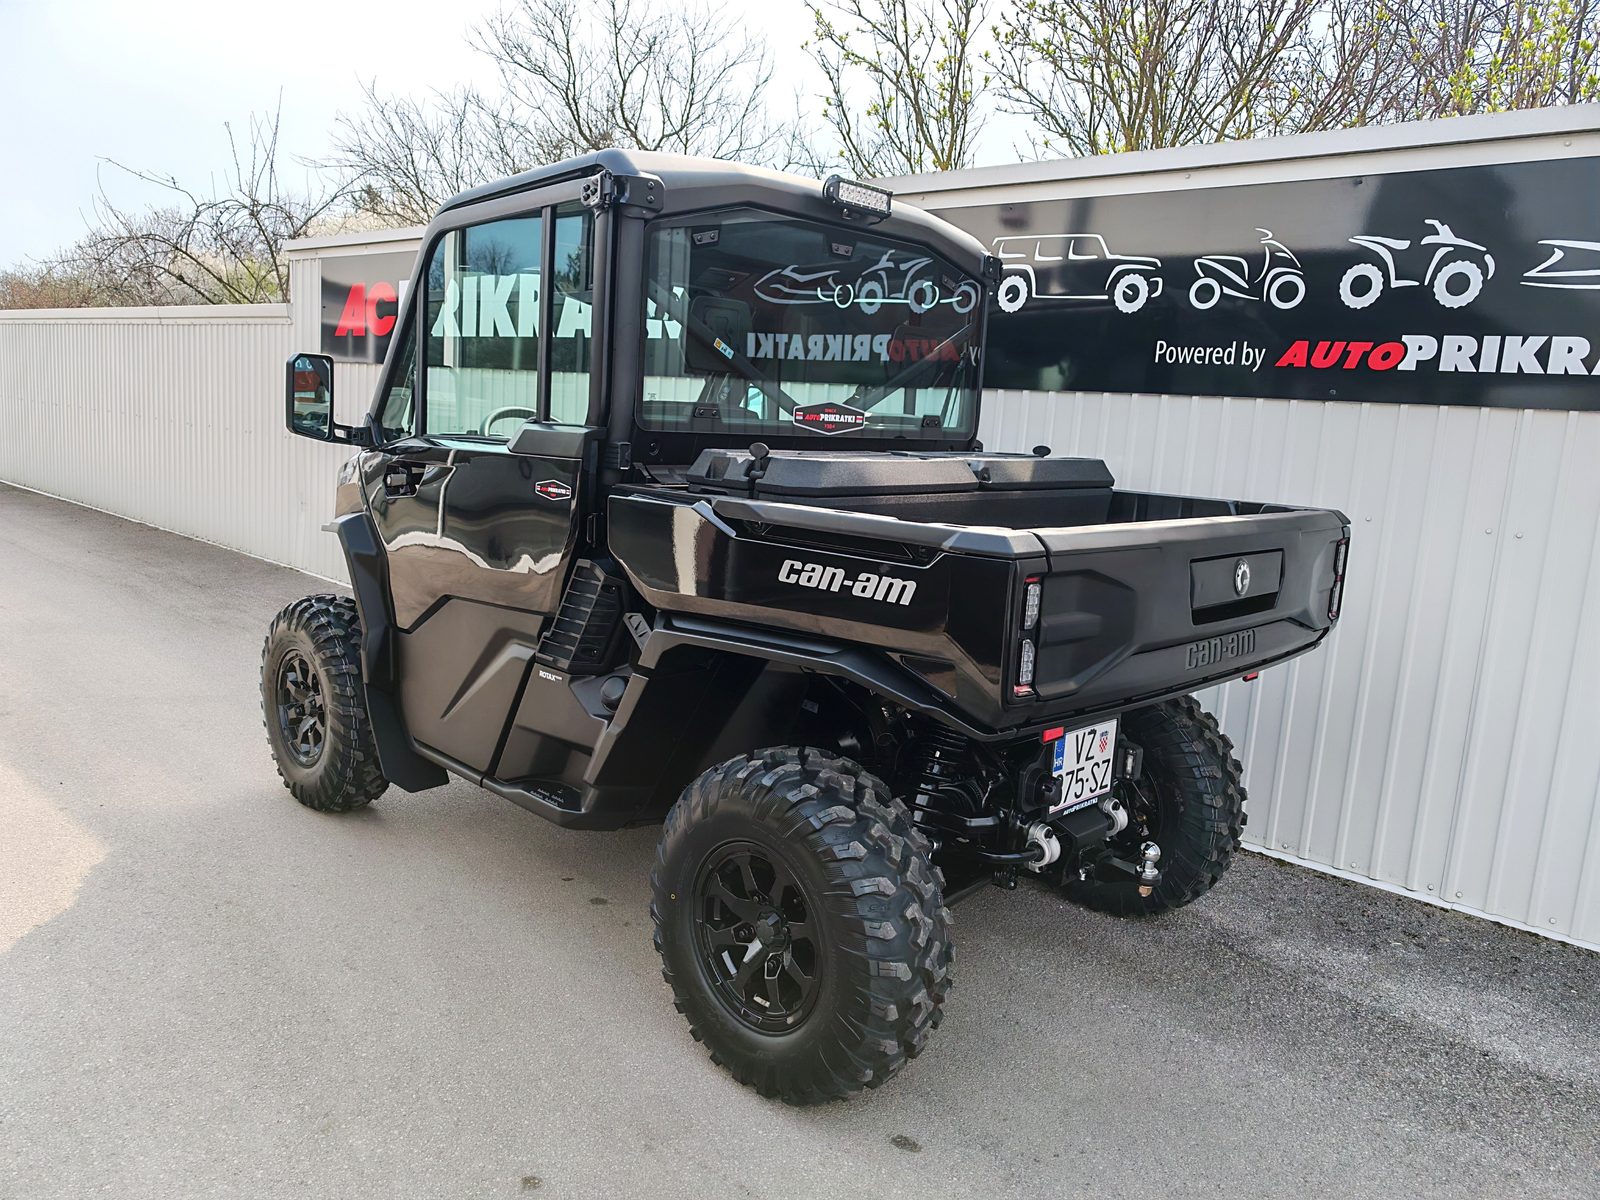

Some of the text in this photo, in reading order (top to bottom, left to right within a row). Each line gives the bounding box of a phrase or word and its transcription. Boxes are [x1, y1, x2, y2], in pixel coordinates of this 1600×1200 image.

[1154, 334, 1600, 375] Powered by AUTOPRIKR
[777, 559, 918, 607] can-am
[1184, 629, 1257, 671] can-am
[1075, 728, 1097, 764] VZ
